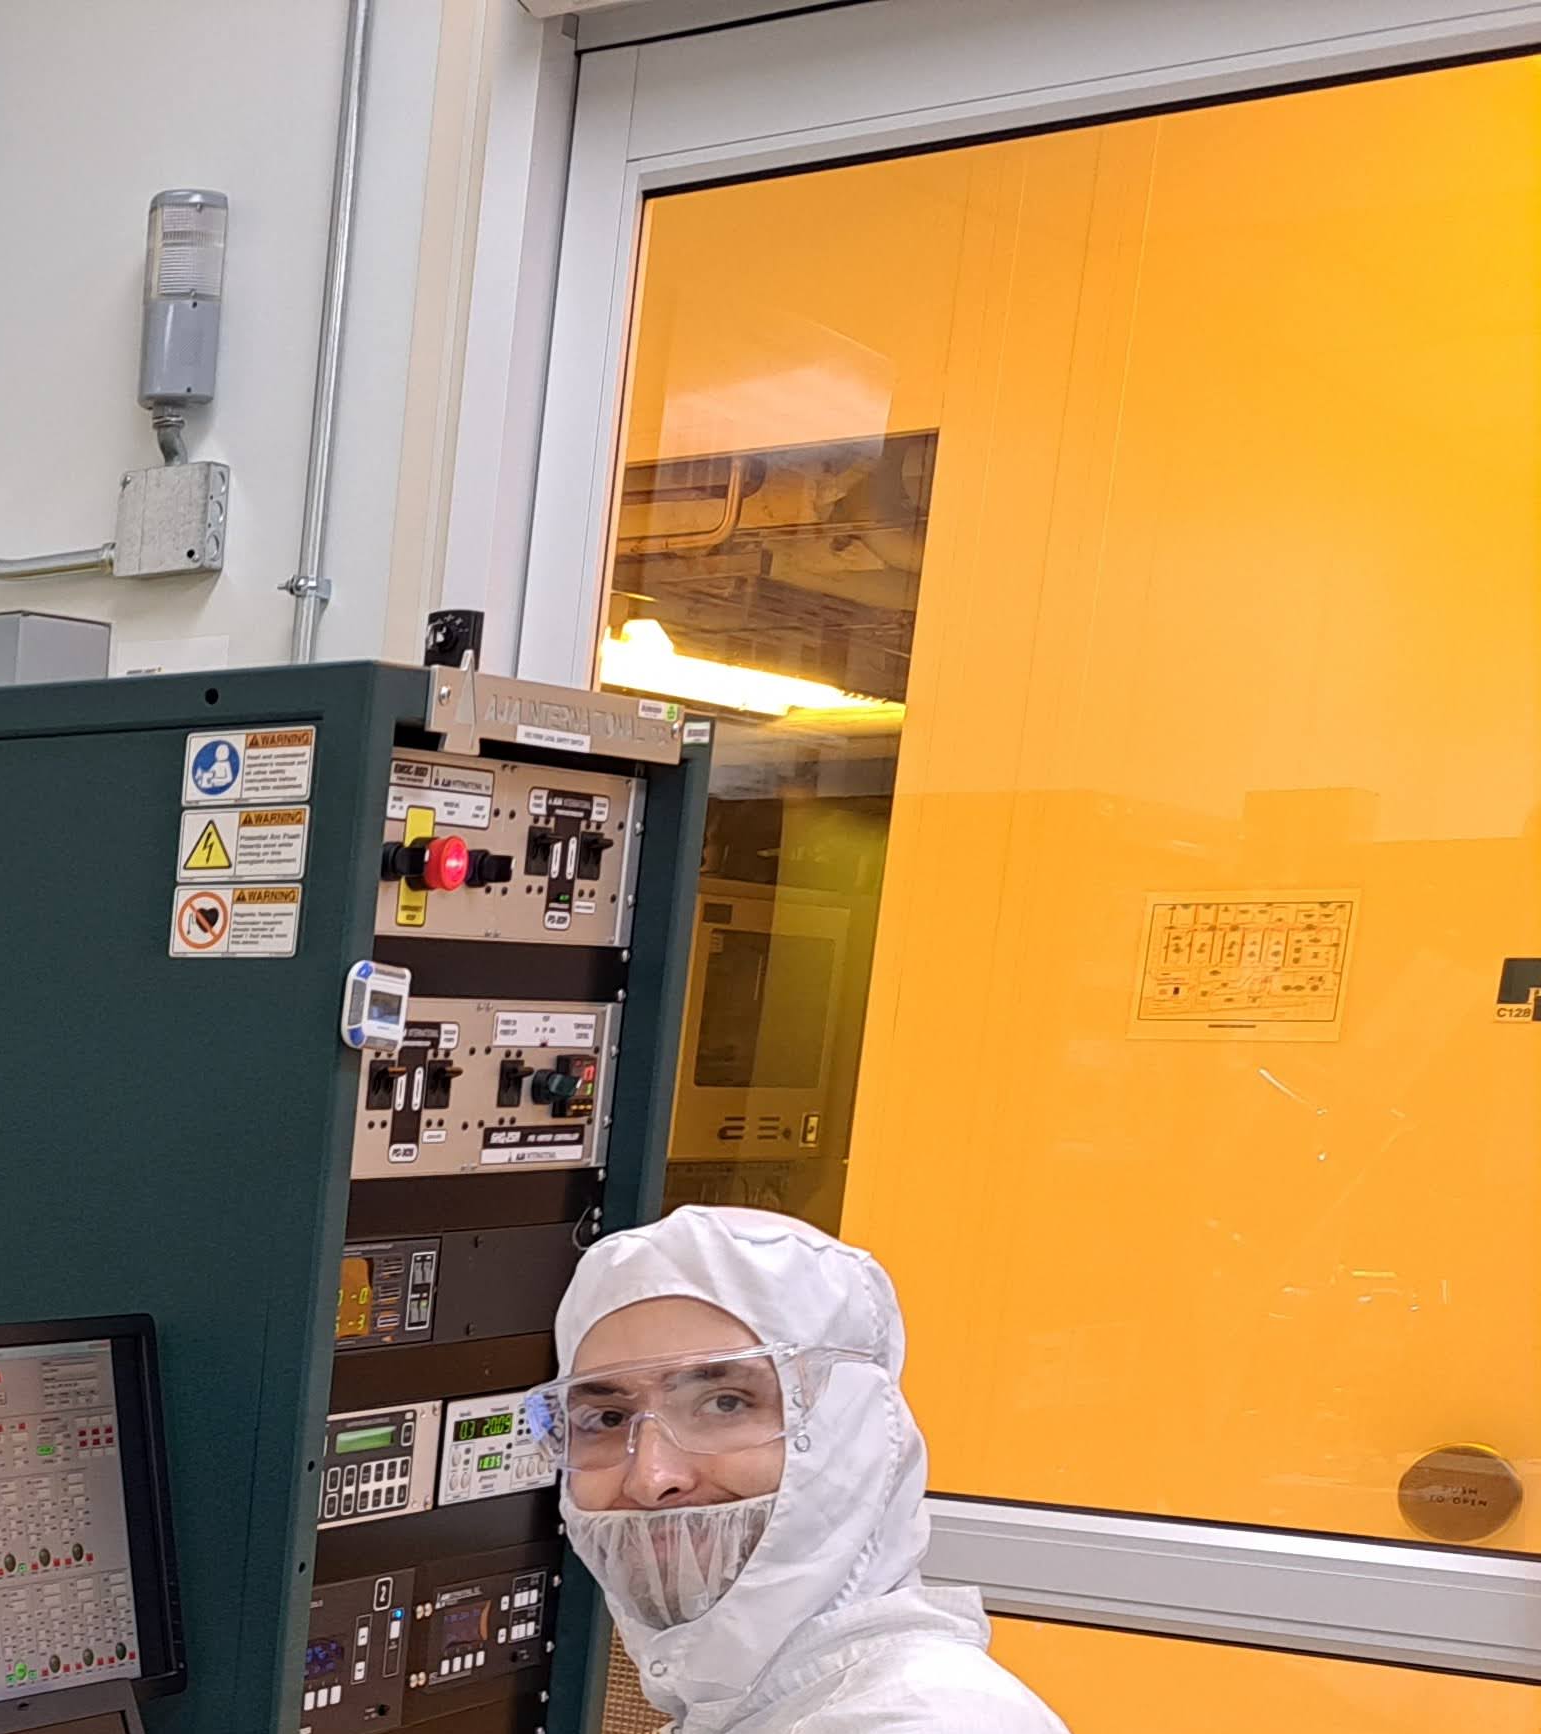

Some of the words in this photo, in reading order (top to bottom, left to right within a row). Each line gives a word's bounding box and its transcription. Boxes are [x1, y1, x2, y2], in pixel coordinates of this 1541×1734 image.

[260, 732, 309, 747] WARNING
[254, 811, 303, 824] WARNING
[248, 888, 295, 902] WARNING
[1497, 1007, 1531, 1018] C128
